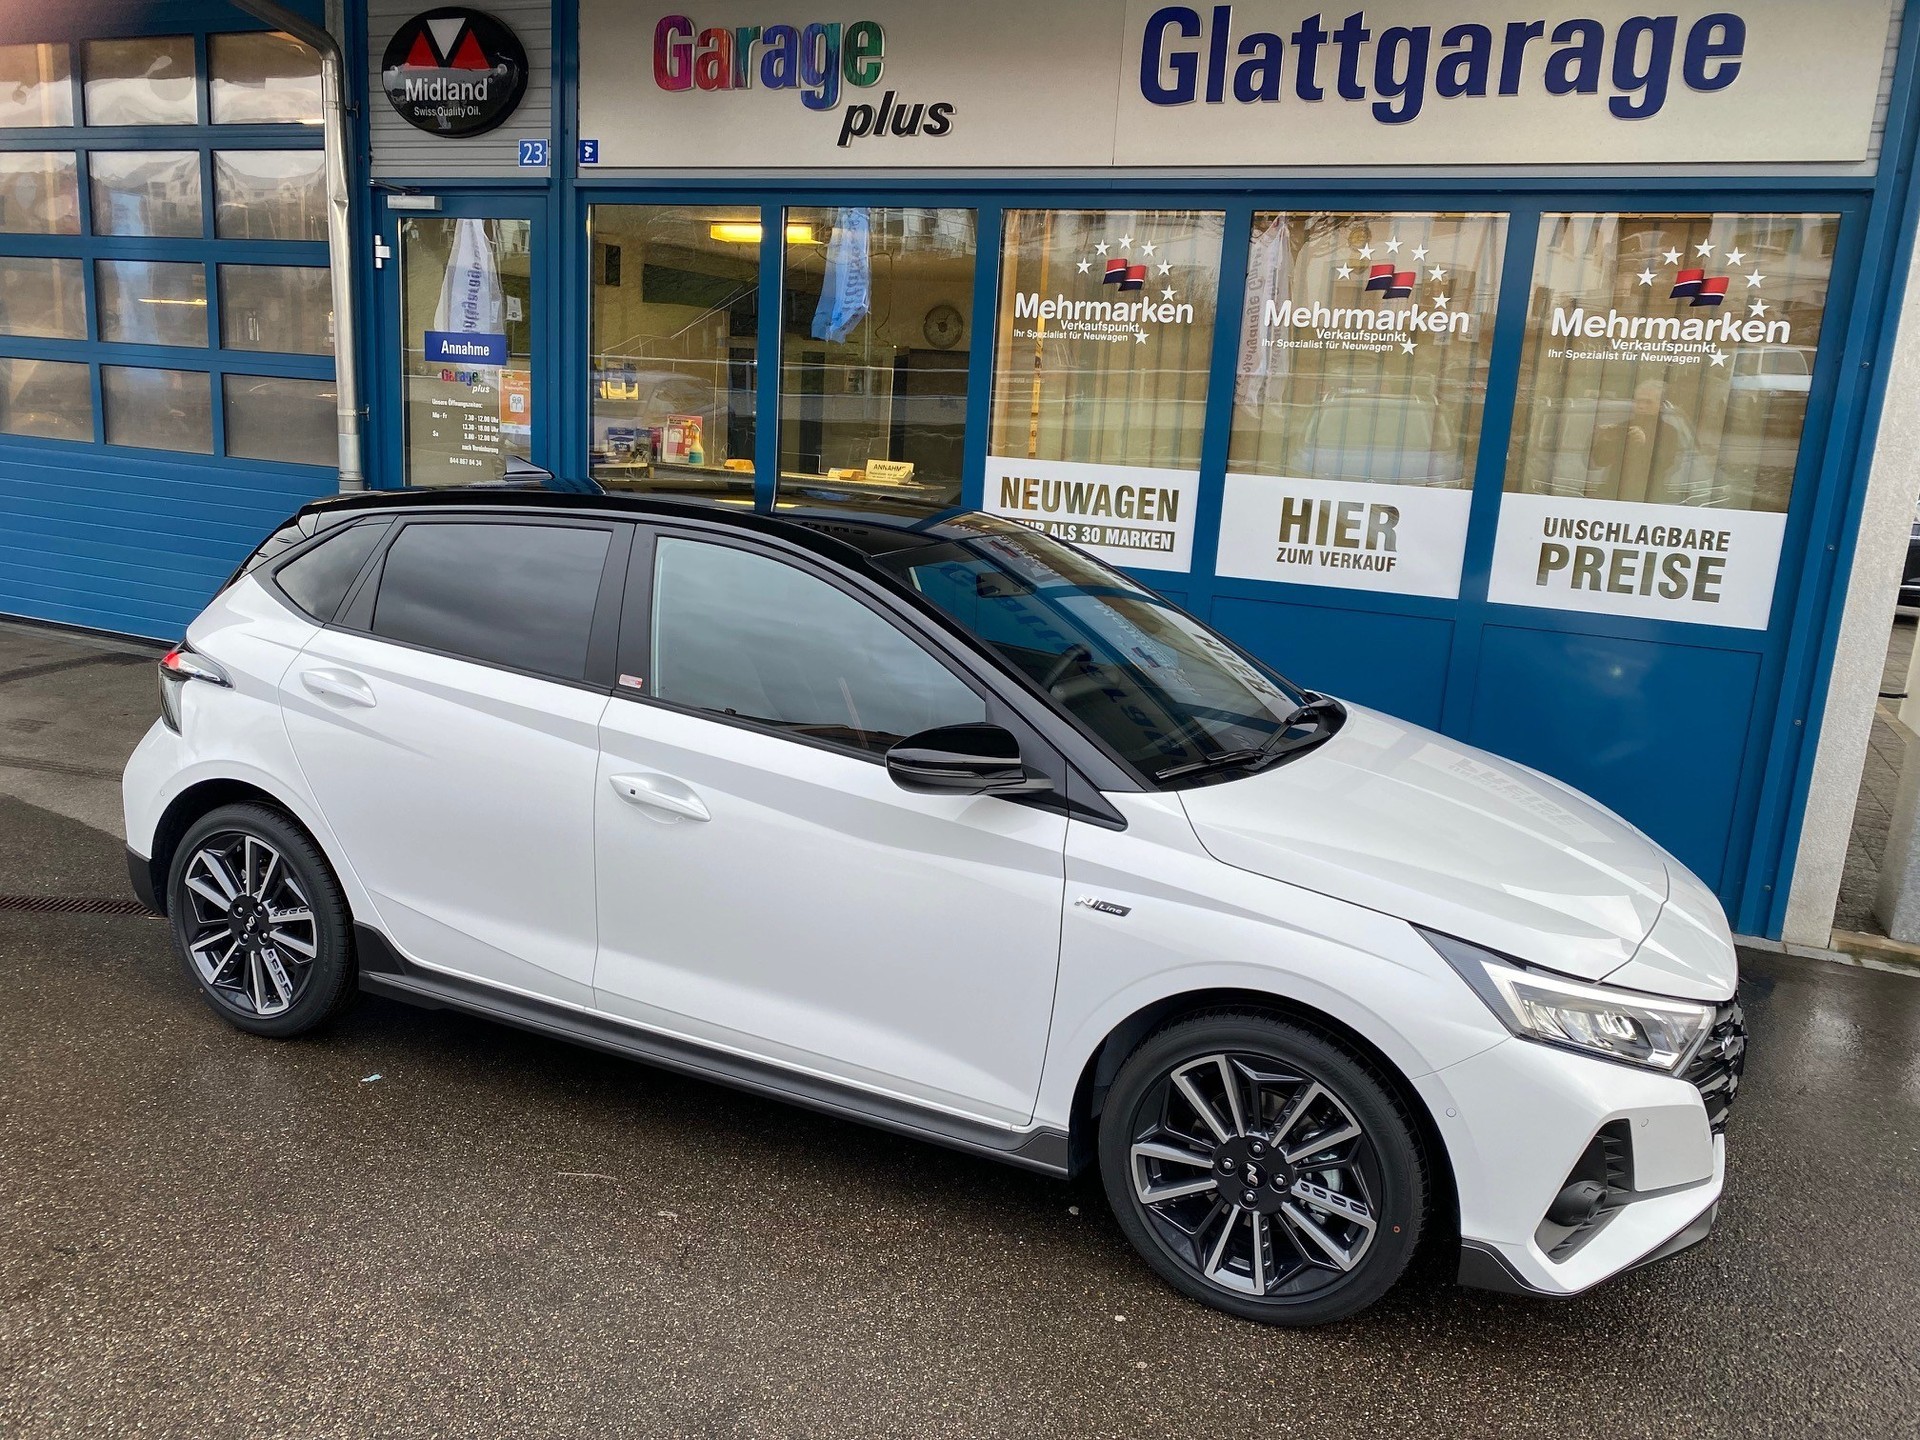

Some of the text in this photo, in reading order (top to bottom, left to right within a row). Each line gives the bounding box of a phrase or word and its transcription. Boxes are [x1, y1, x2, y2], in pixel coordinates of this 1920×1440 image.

[652, 14, 886, 110] Garage
[1139, 6, 1746, 125] Glattgarage
[405, 78, 488, 101] Midland
[414, 106, 481, 118] Swiss Quality Oil.
[836, 91, 956, 147] plus
[522, 143, 543, 164] 23
[1014, 292, 1194, 324] Mehrmarken
[1264, 299, 1470, 333] Mehrmarken
[1013, 329, 1128, 343] Ihr Spezialist für Neuwagen
[1060, 320, 1140, 333] Verkaufspunkt
[1316, 328, 1407, 343] Verkaufspunkt
[1551, 307, 1791, 344] Mehrmarken
[440, 340, 490, 356] Annahme
[1261, 338, 1394, 353] Ihr Spezialist für Neuwagen
[1548, 349, 1701, 364] Ihr Spezialist für Neuwagen
[1611, 338, 1717, 354] Verkaufspunkt
[441, 368, 480, 386] Garage
[472, 384, 491, 394] plus
[1000, 476, 1180, 523] NEUWAGEN
[1050, 521, 1077, 541] ALS
[1081, 526, 1100, 543] 30
[1105, 528, 1172, 550] MARKEN
[1278, 497, 1400, 552] HIER
[1543, 517, 1731, 552] UNSCHLAGBARE
[1276, 547, 1397, 573] ZUM VERKAUF
[1536, 542, 1727, 603] PREISE
[1099, 903, 1123, 914] Line
